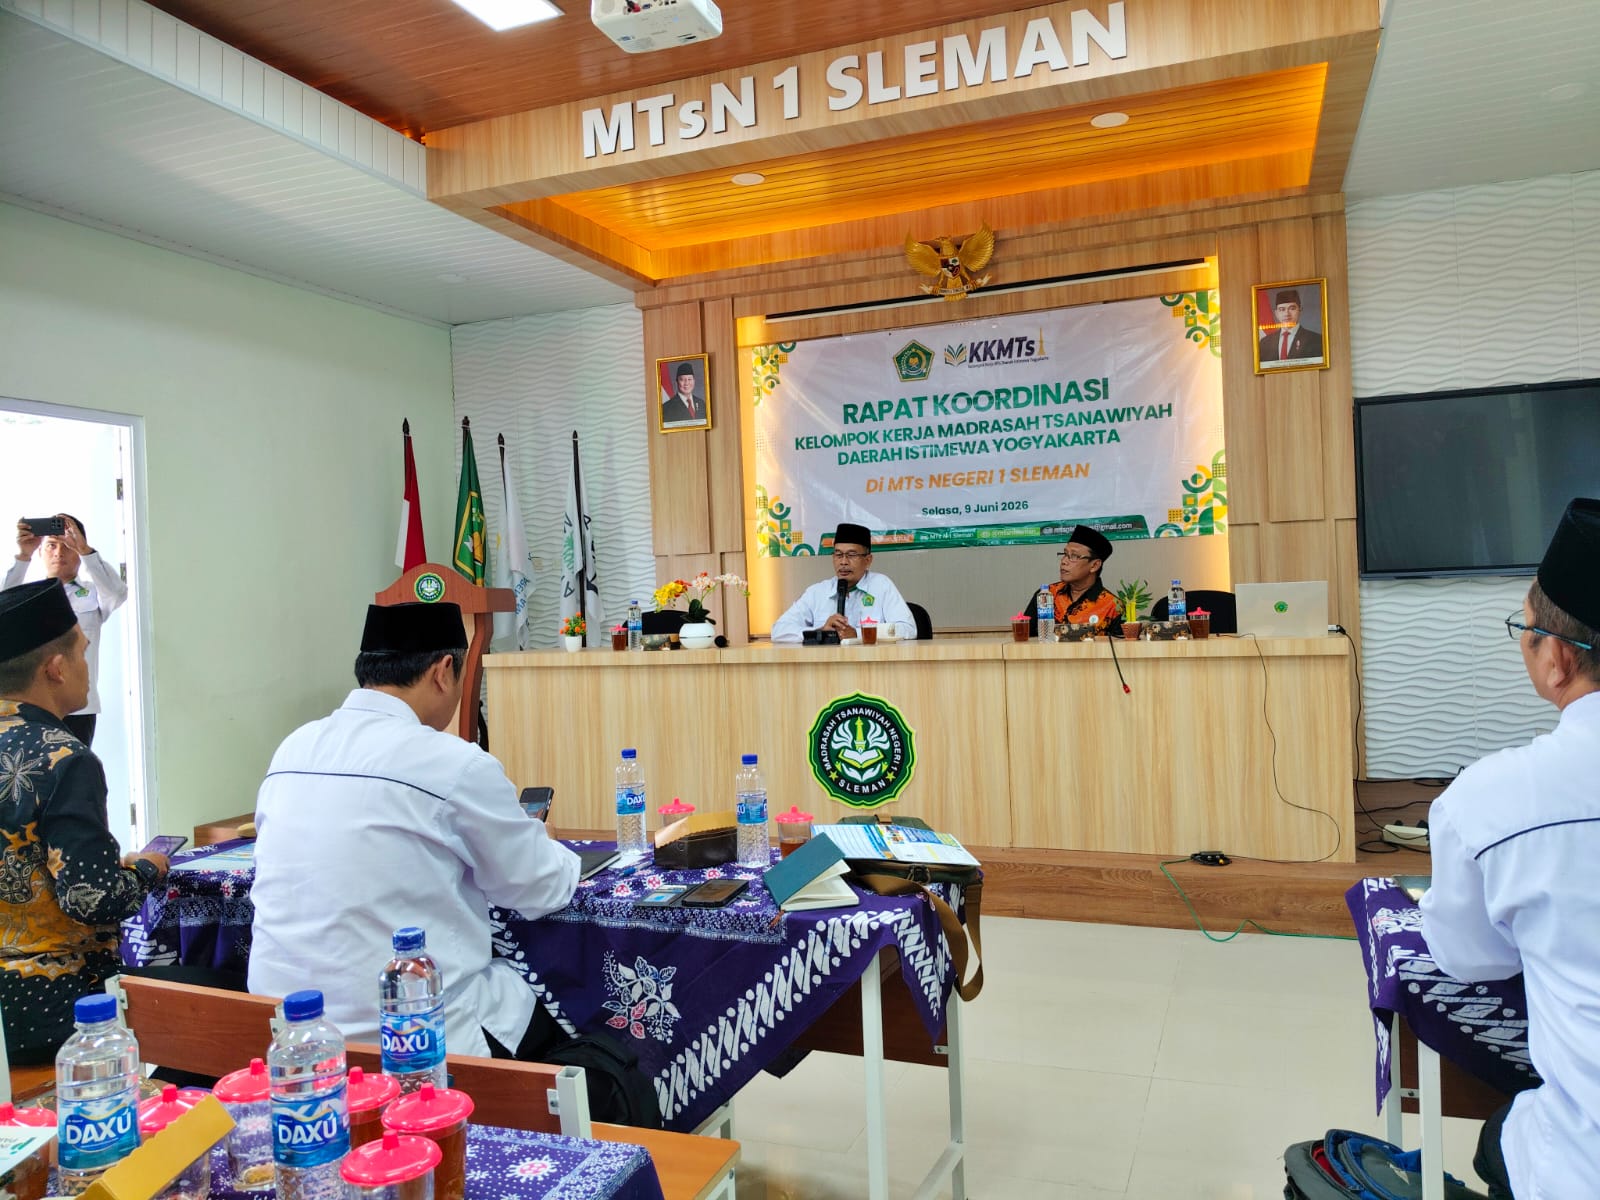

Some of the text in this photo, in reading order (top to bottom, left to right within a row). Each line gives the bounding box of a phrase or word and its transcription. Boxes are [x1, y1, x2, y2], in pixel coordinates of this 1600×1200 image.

[582, 1, 1128, 158] MTsN 1 SLEMAN
[969, 336, 1035, 363] KKMTs
[842, 377, 1109, 424] RAPAT KOORDINASI
[795, 403, 1173, 450] KELOMPOK KERJA MADRASAH TSANAWIYAH
[837, 428, 1121, 465] DAERAH ISTIMEWA YOGYAKARTA
[866, 463, 1091, 493] Di MTs NEGERI 1 SLEMAN
[921, 501, 1029, 516] Selasa, 9 Juni 2026
[821, 719, 837, 771] MADRASAH
[835, 707, 891, 729] TSANAWIYAH
[888, 728, 902, 765] NEGERI
[838, 779, 887, 793] SLEMAN
